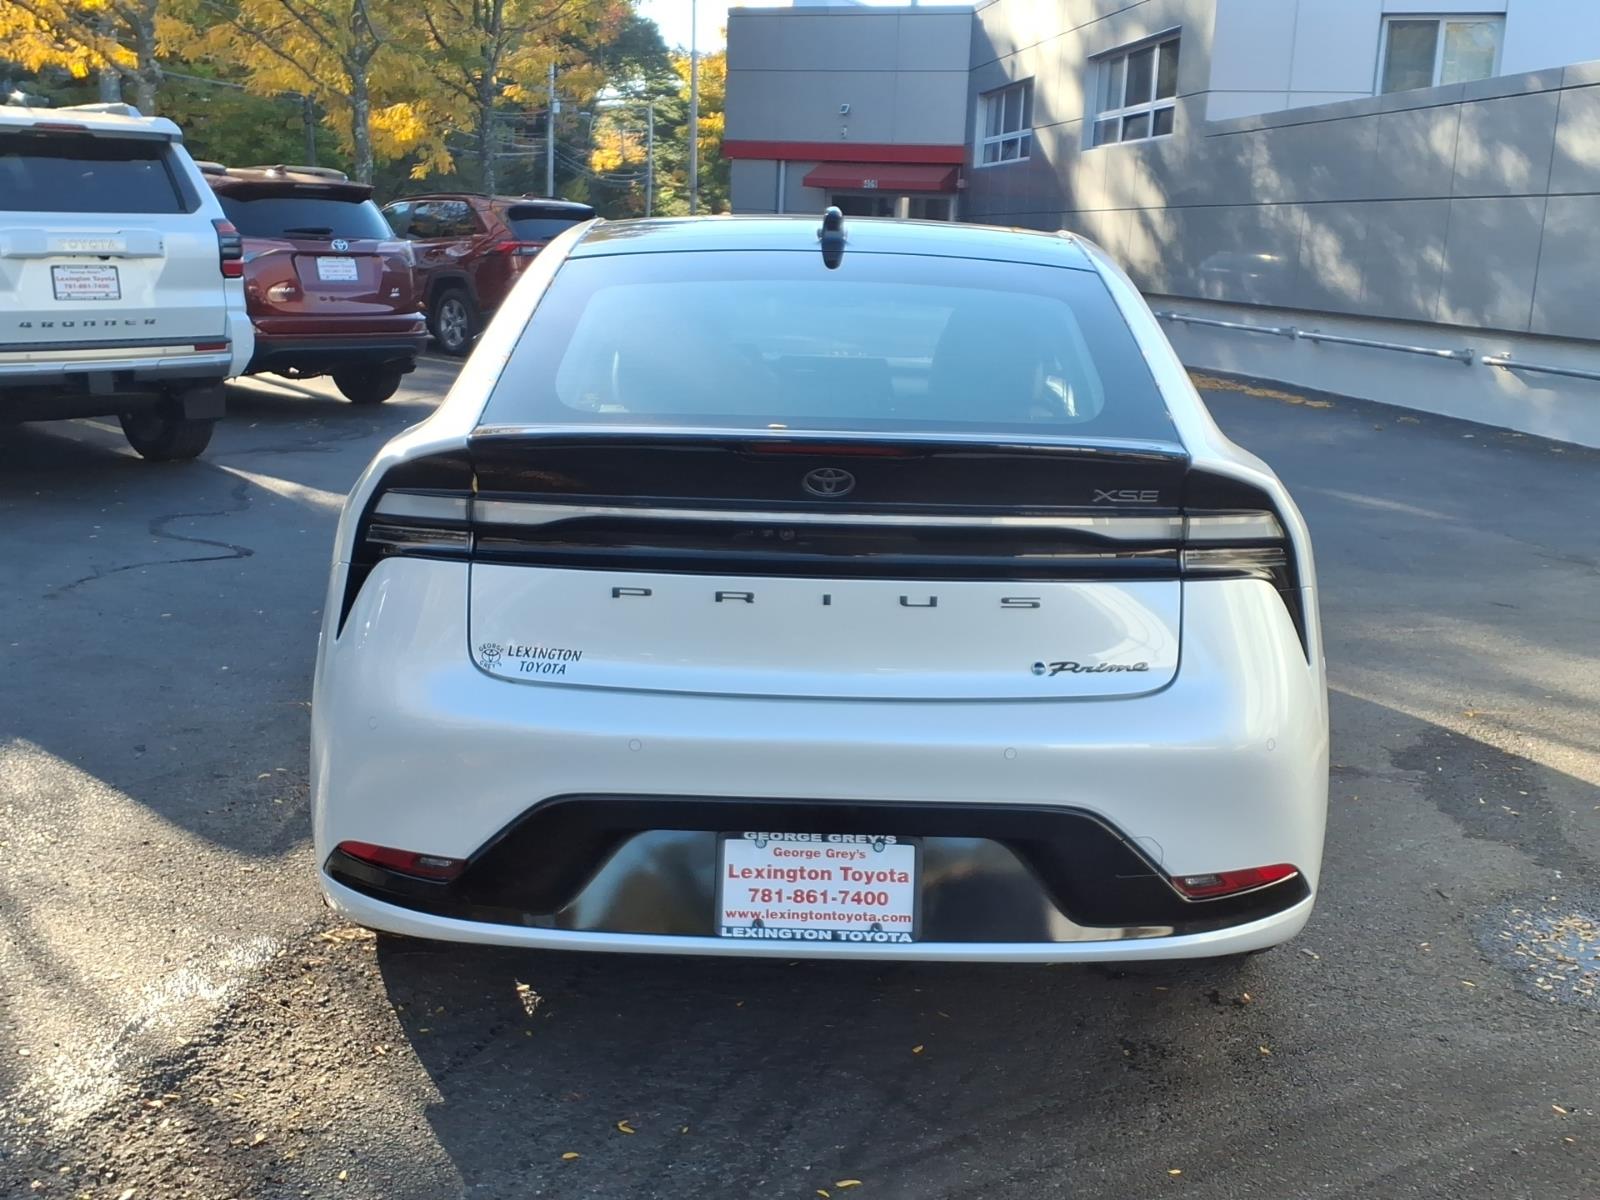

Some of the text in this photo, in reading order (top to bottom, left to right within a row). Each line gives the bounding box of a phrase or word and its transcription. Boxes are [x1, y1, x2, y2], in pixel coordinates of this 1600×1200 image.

[58, 240, 114, 249] TOYOTA
[1093, 489, 1160, 502] XSE
[611, 587, 1041, 609] PRIUS
[507, 644, 583, 662] LEXINGTON
[519, 660, 567, 675] TOYOTA
[1048, 661, 1150, 676] Prime
[743, 831, 897, 844] GEORGE GREY'S
[773, 847, 866, 860] George Grey's
[728, 863, 910, 885] Lexington Toyota
[748, 888, 888, 905] 781-861-7400
[725, 908, 912, 923] www.lexingtontoyota.com
[721, 927, 913, 943] LEXINGTON TOYOTA
